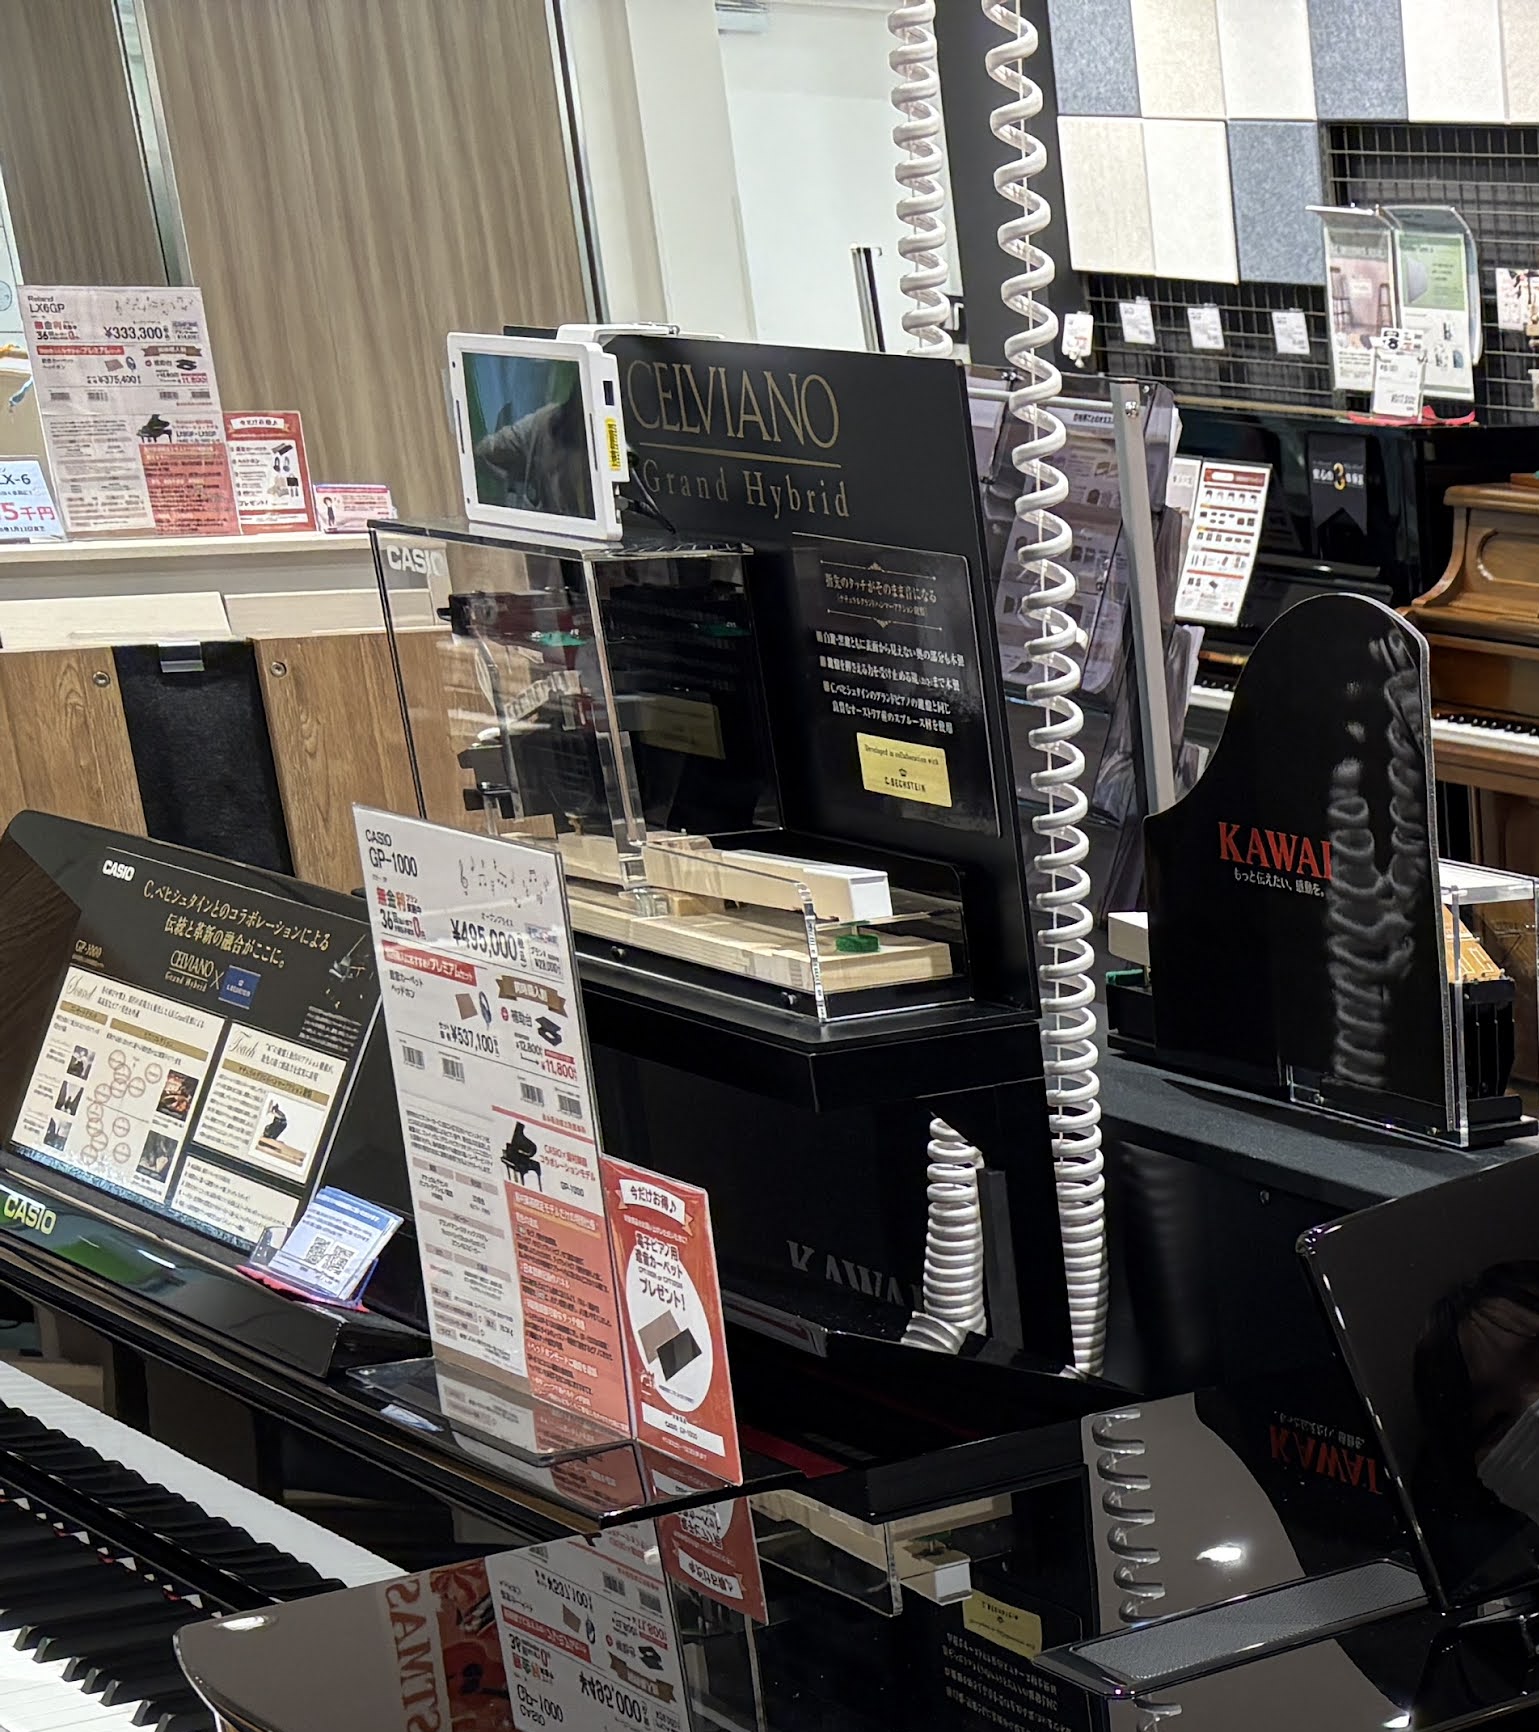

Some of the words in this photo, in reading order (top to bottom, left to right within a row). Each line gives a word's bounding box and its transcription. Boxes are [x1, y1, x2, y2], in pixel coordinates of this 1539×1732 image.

[103, 326, 164, 340] ¥333,300
[626, 358, 840, 450] CELVIANO
[643, 457, 729, 503] Grand
[742, 469, 850, 520] Hybrid
[386, 543, 447, 579] CASIO
[365, 828, 393, 847] CASIO
[1217, 821, 1333, 880] KAWAI
[102, 859, 136, 882] CASIO
[369, 846, 418, 878] GP-1000
[1232, 867, 1326, 899] もっと伝えたい、感動を。
[142, 878, 333, 952] C.ベヒシュタインとのコラボレーションによる
[164, 911, 286, 969] 伝統と革新の融合がここに。
[450, 918, 517, 961] ¥495,000
[450, 1025, 494, 1054] ¥537,100
[2, 1196, 58, 1236] CASIO
[635, 1232, 680, 1261] 電子ピアノ用
[638, 1277, 686, 1312] プレゼント!
